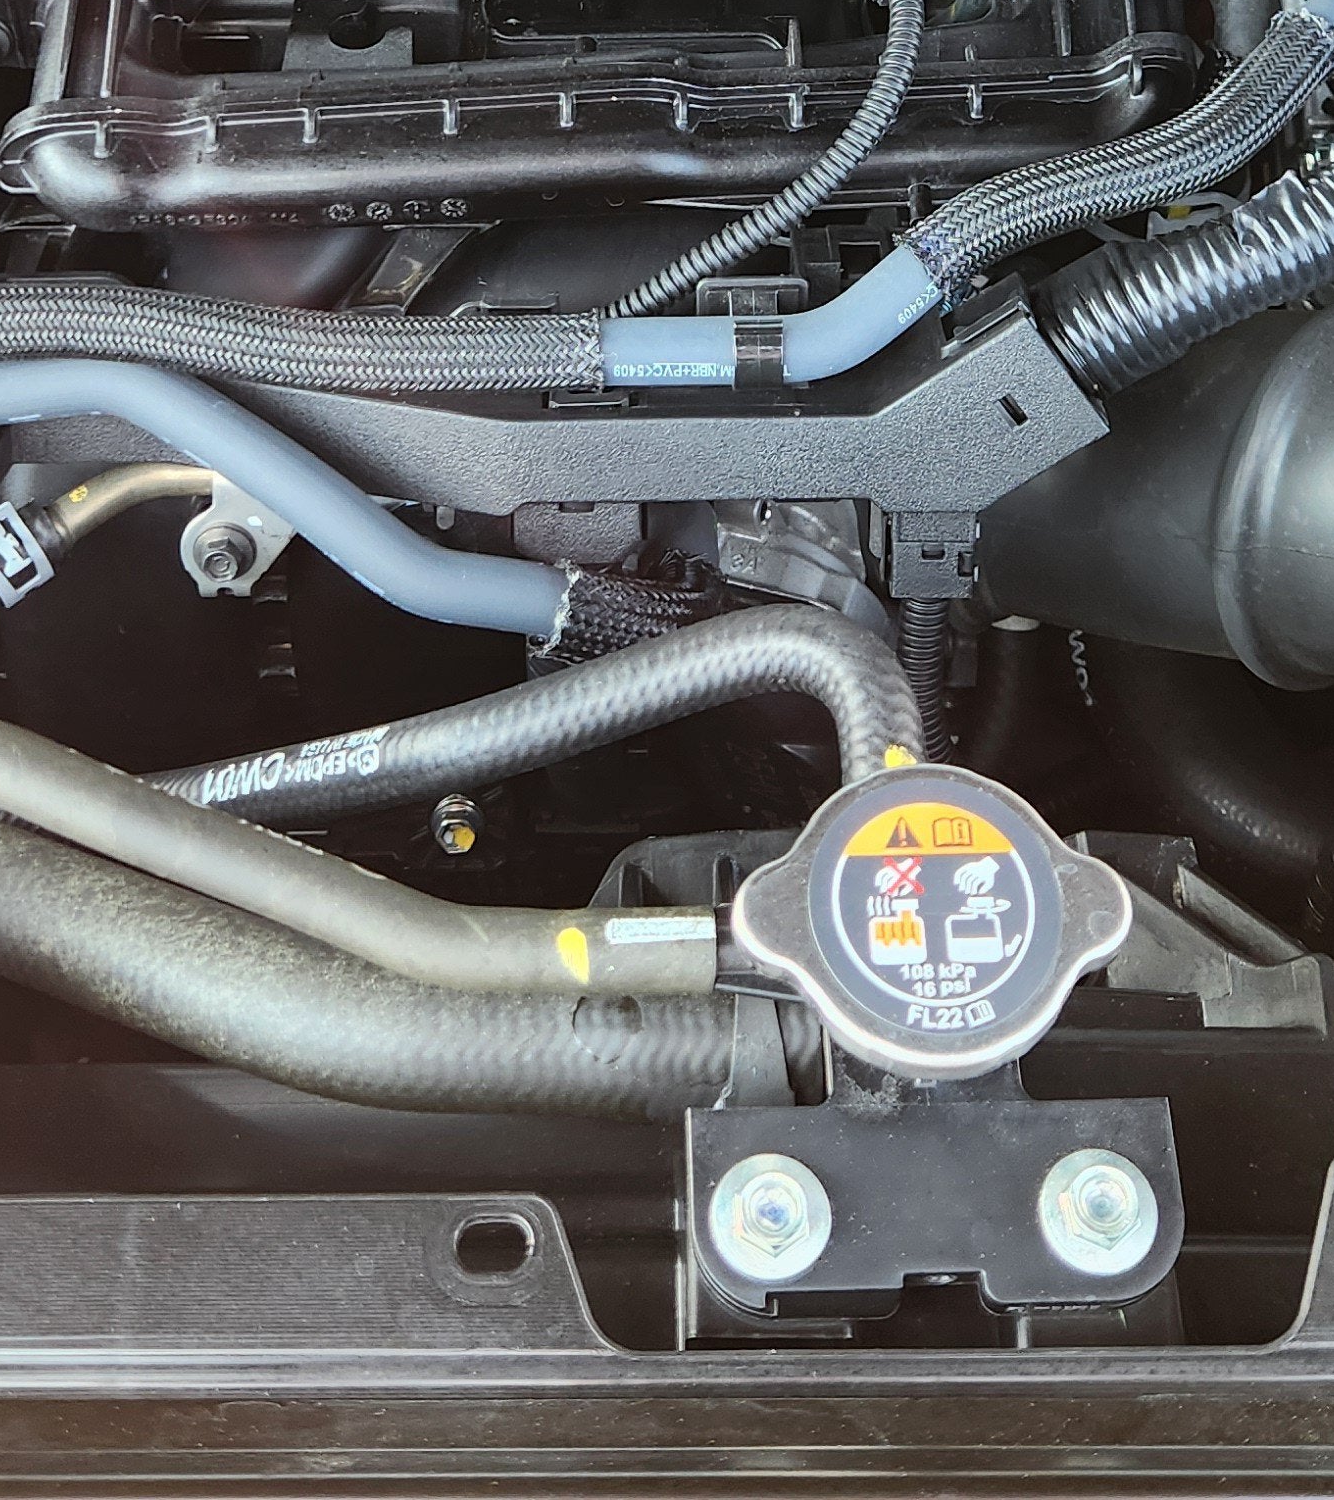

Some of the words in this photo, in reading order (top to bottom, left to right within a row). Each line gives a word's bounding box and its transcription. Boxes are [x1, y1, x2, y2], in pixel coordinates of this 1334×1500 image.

[898, 963, 936, 980] 108
[937, 962, 977, 980] kPa
[911, 980, 937, 998] 16
[939, 977, 972, 997] psi
[907, 1003, 965, 1030] FL22
